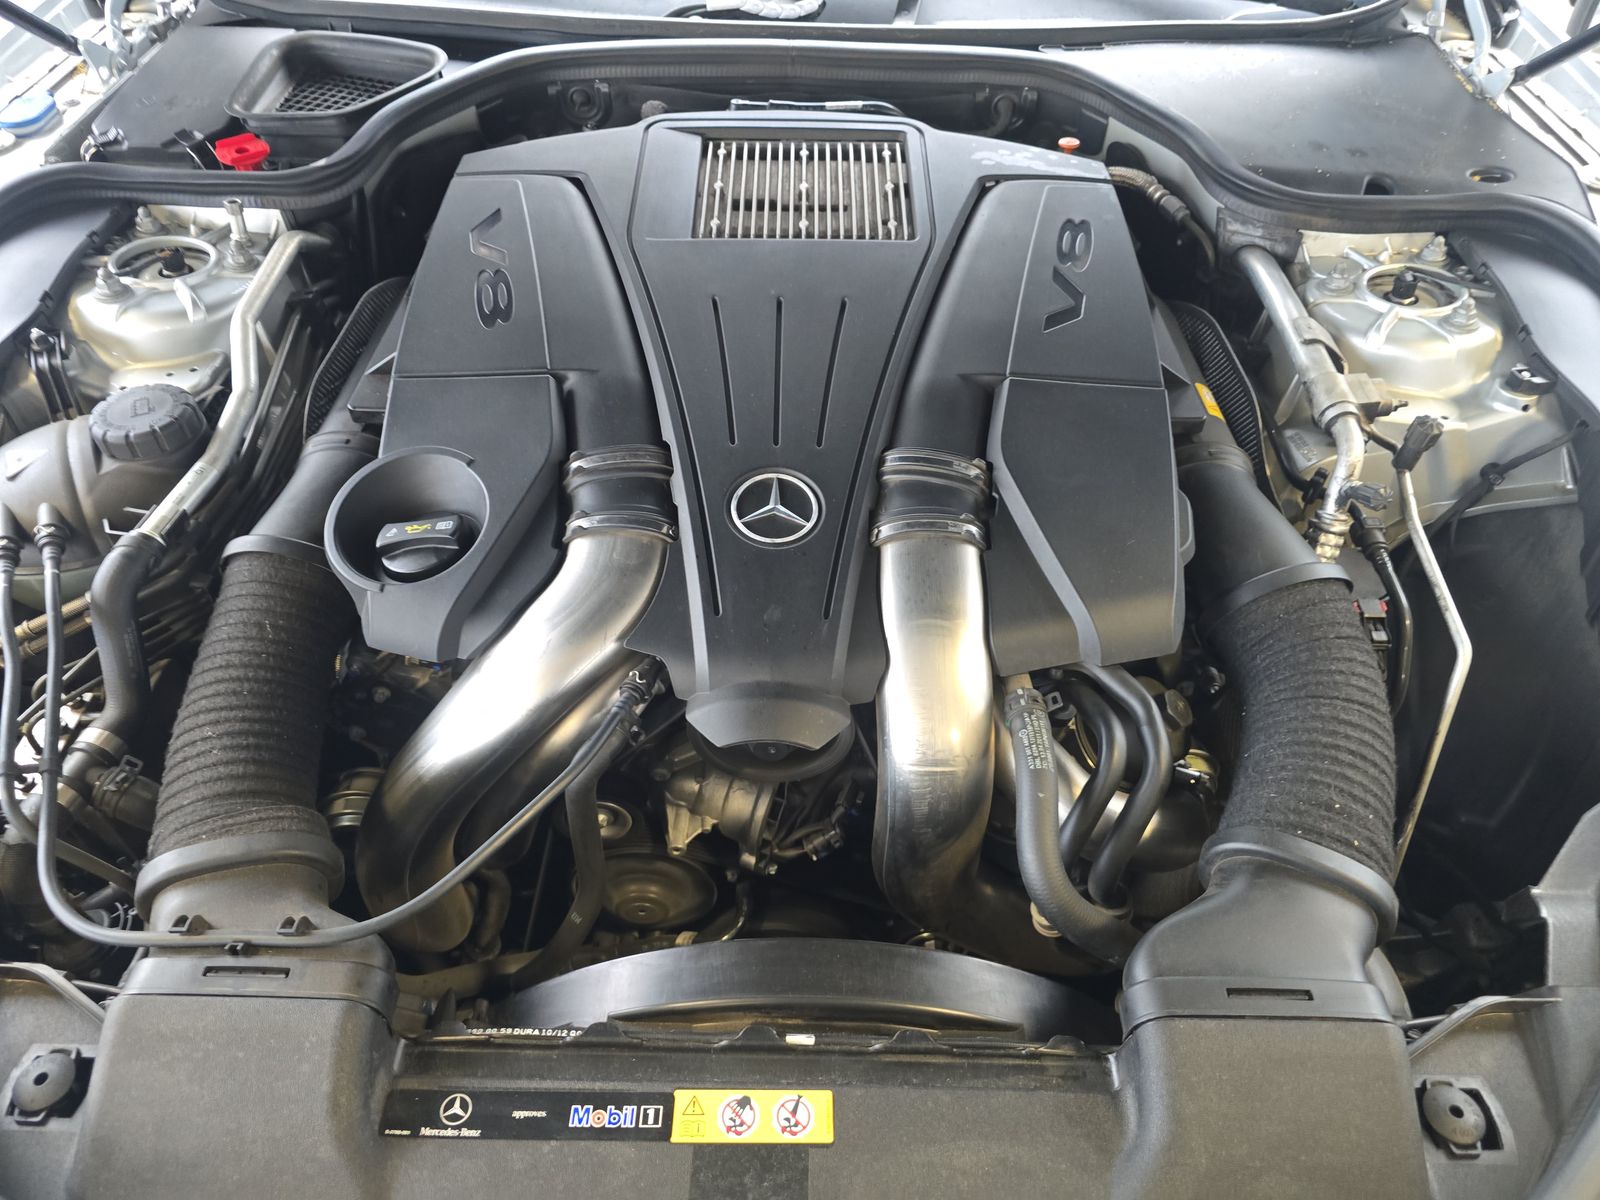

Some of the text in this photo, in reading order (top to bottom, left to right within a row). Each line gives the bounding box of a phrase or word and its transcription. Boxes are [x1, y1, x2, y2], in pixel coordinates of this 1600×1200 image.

[469, 207, 516, 330] V8
[1042, 217, 1094, 333] V8
[513, 1027, 540, 1036] DURA
[568, 1104, 637, 1128] Mobil
[419, 1126, 481, 1138] Mercedes-Benz
